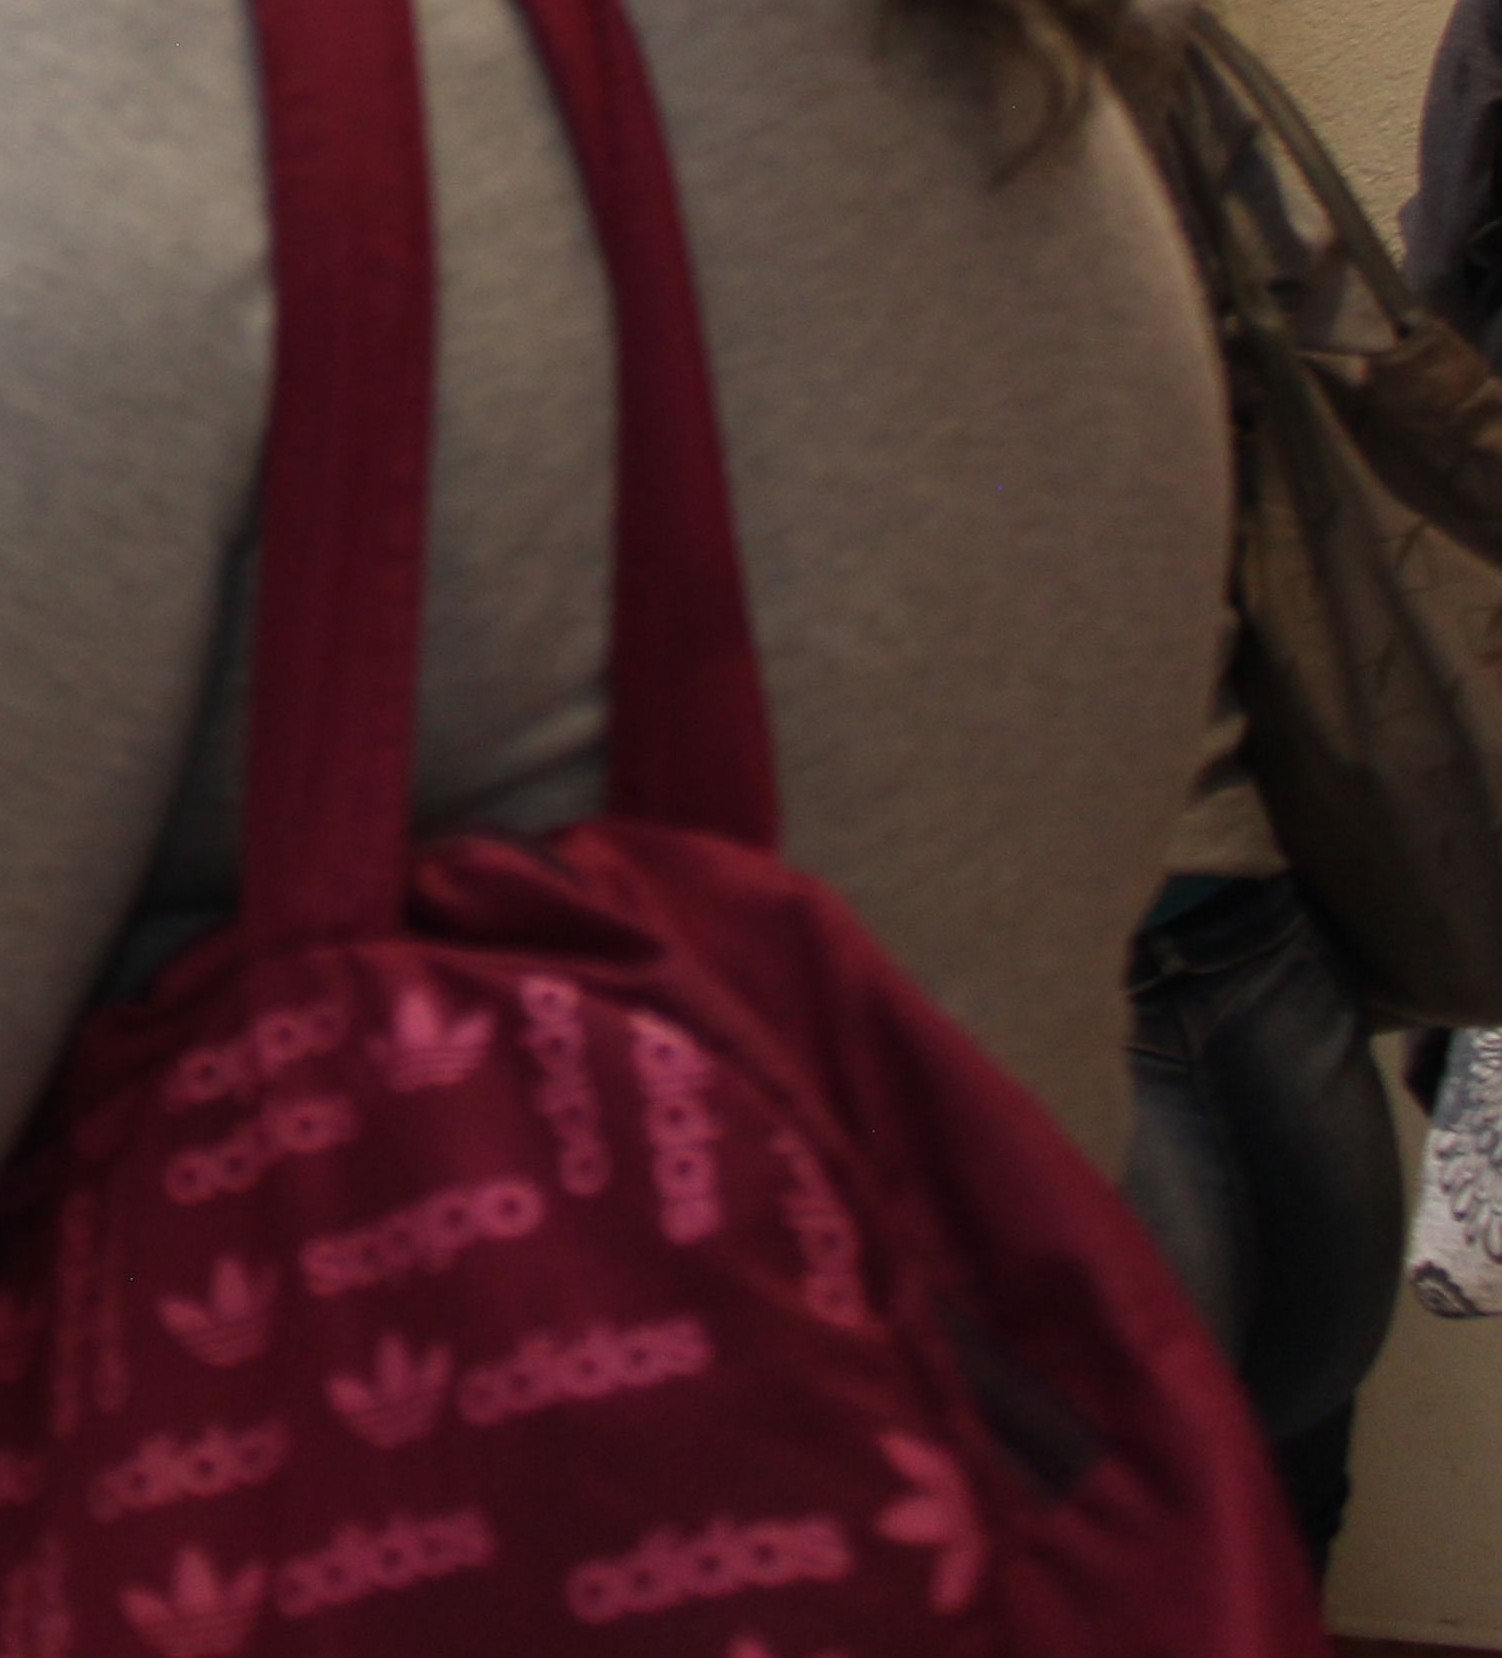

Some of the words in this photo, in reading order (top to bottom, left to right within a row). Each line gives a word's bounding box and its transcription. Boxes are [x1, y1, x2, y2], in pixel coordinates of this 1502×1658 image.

[458, 1314, 714, 1426] adidas
[274, 1502, 498, 1618] adidas
[564, 1510, 854, 1626] adidas
